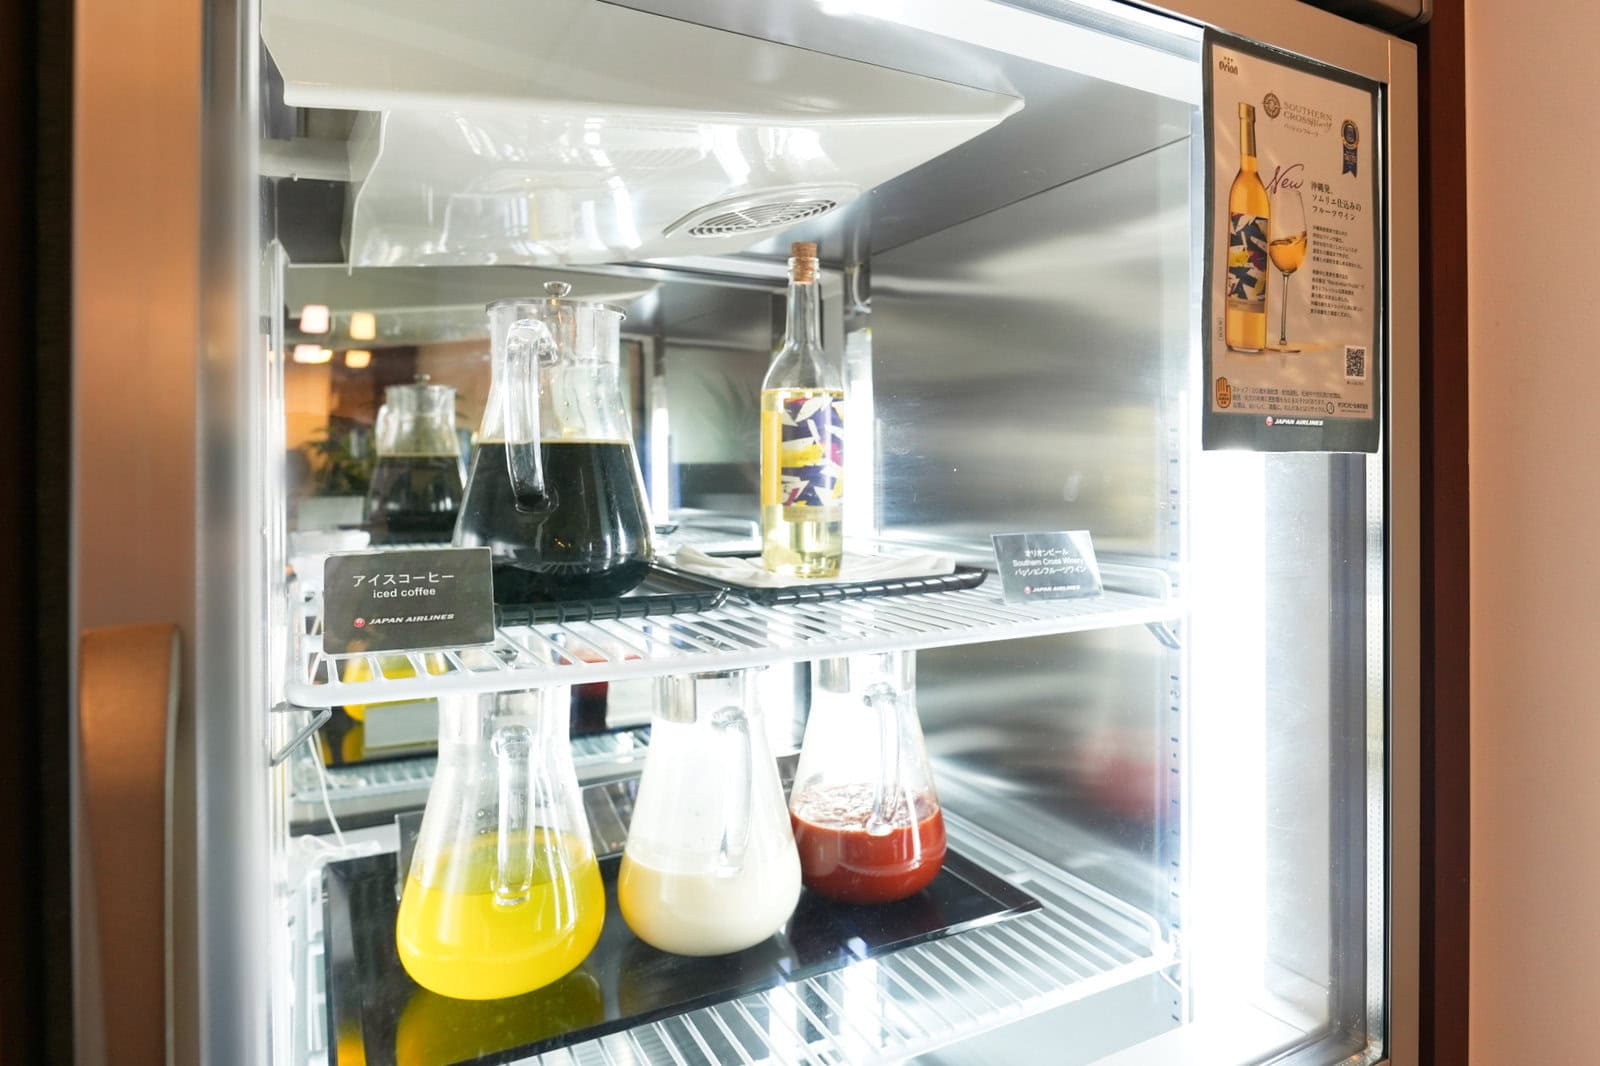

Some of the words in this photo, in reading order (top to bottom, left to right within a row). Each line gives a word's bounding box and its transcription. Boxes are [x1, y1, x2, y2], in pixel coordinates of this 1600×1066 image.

[1218, 60, 1239, 76] Orion
[1283, 101, 1333, 122] SOUTHERN
[1265, 163, 1304, 194] New
[1274, 417, 1295, 426] JAPAN
[1012, 559, 1042, 568] Southern
[1042, 558, 1062, 567] Cross
[1062, 557, 1084, 567] Winery
[352, 571, 455, 588] アイスコーヒー
[372, 588, 397, 599] iced
[401, 586, 436, 597] coffee
[369, 617, 403, 625] JAPAN
[405, 613, 455, 623] AIRLINES
